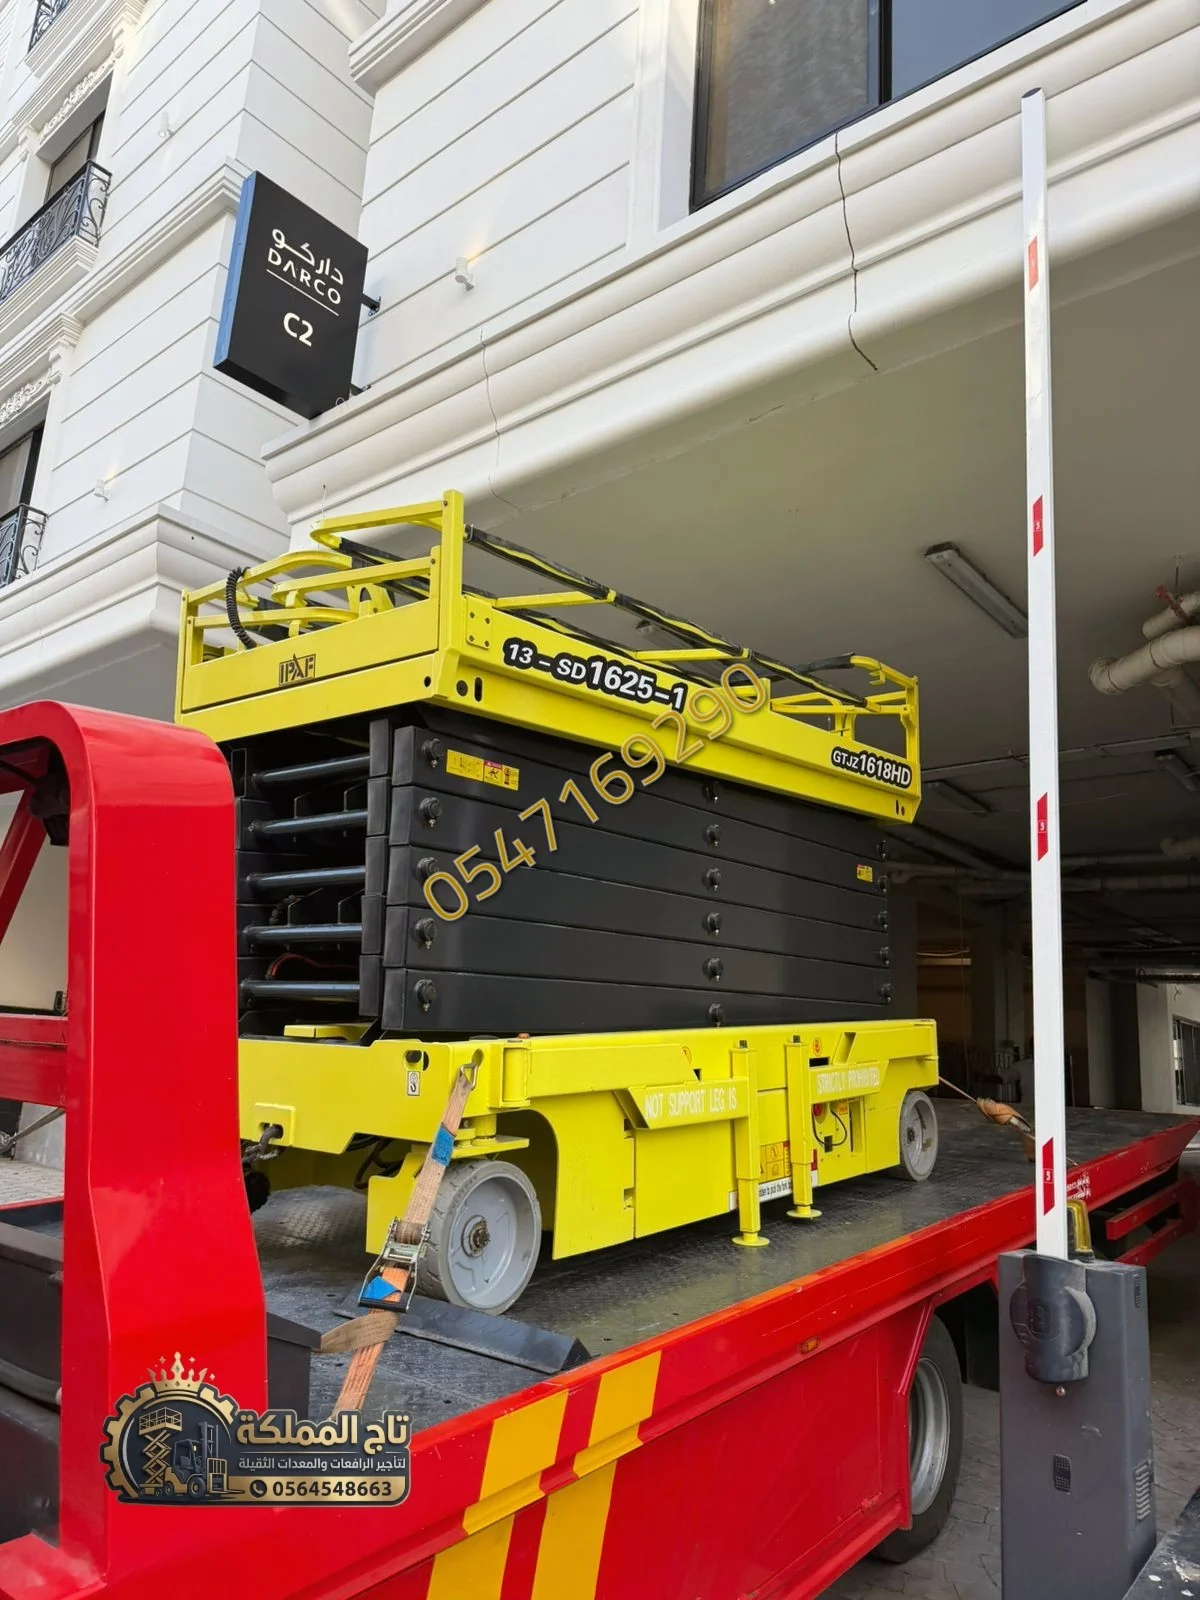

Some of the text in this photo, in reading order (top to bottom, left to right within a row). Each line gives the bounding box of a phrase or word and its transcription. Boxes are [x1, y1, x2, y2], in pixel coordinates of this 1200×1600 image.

[268, 247, 341, 305] DARCO
[283, 311, 314, 347] C2
[280, 653, 315, 683] IPAF
[832, 750, 911, 786] GTJZ1618HD
[645, 1087, 737, 1119] NOT SUPPORT LEG IS
